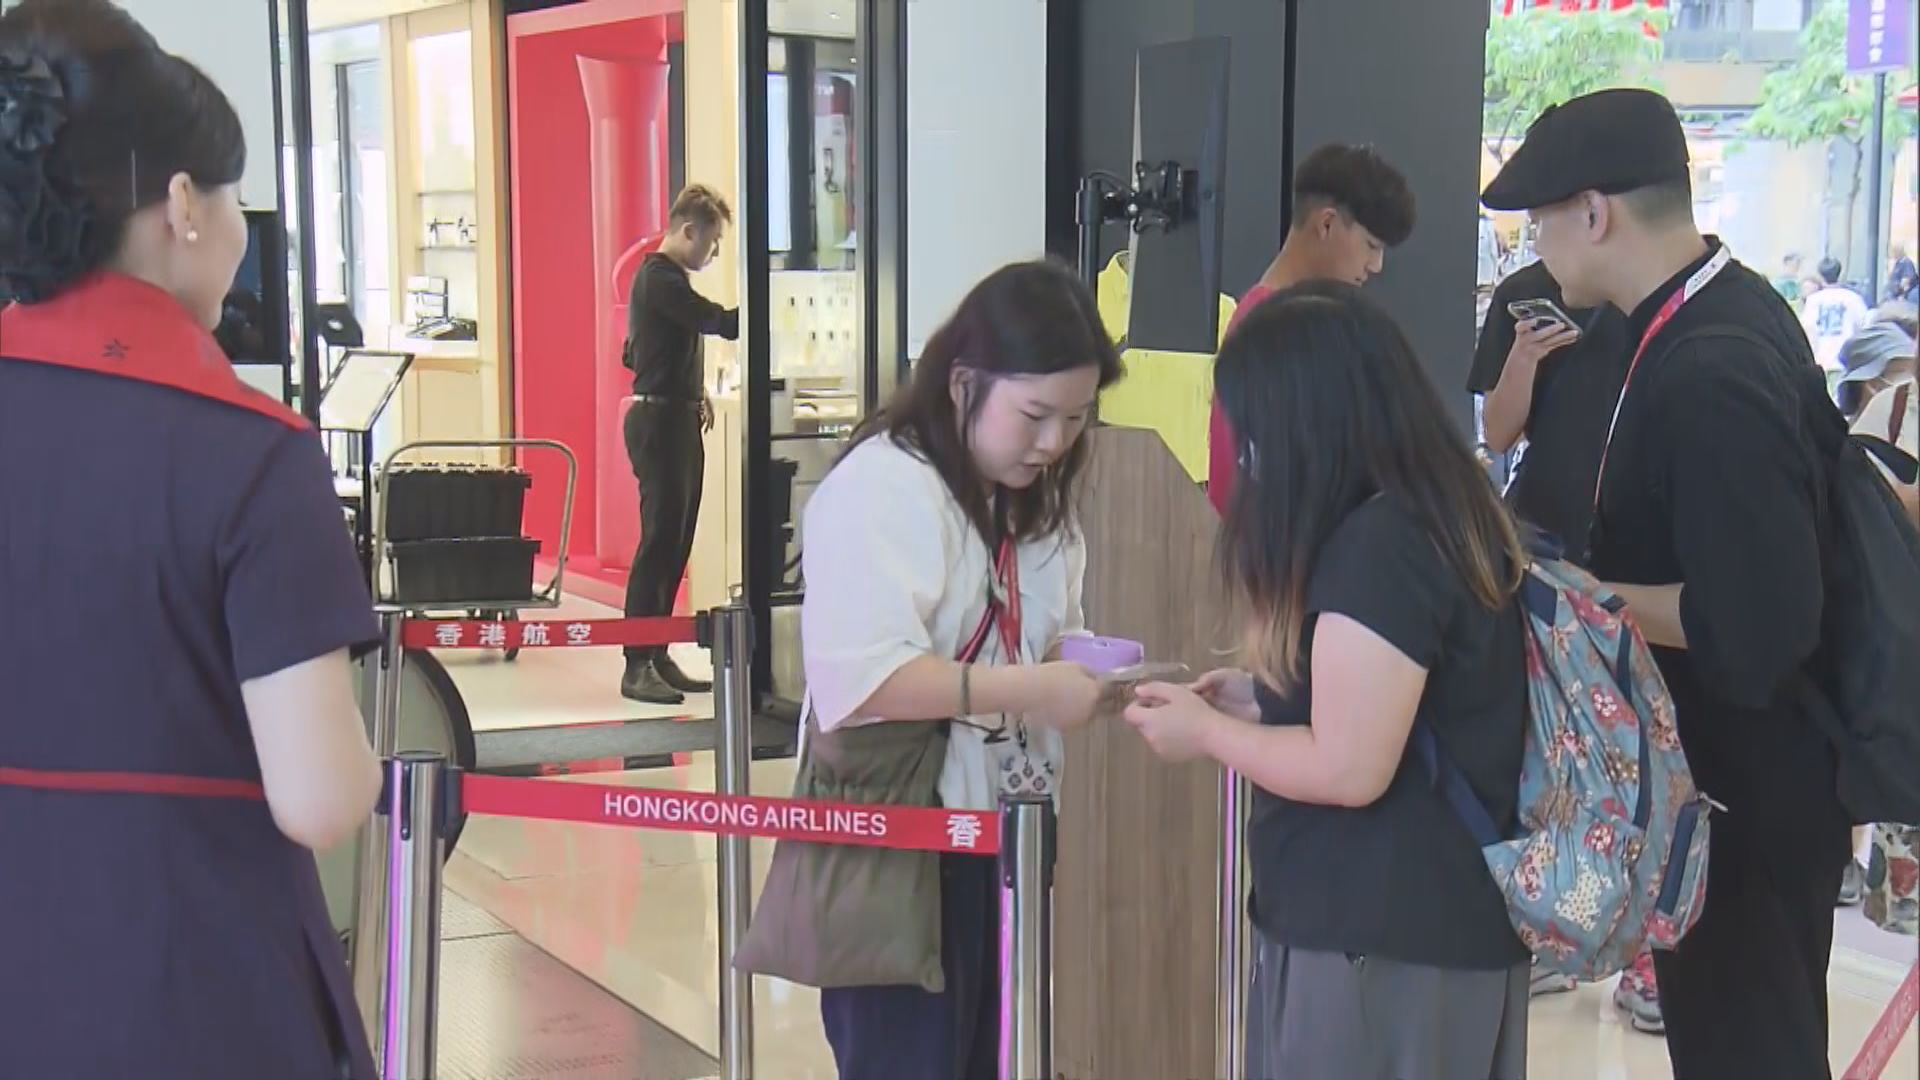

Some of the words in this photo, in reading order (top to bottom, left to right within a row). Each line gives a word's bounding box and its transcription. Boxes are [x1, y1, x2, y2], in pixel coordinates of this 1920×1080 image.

[435, 622, 591, 646] 香港航空
[604, 792, 757, 827] HONGKONG
[763, 806, 886, 836] AIRLINES
[947, 814, 981, 848] 香
